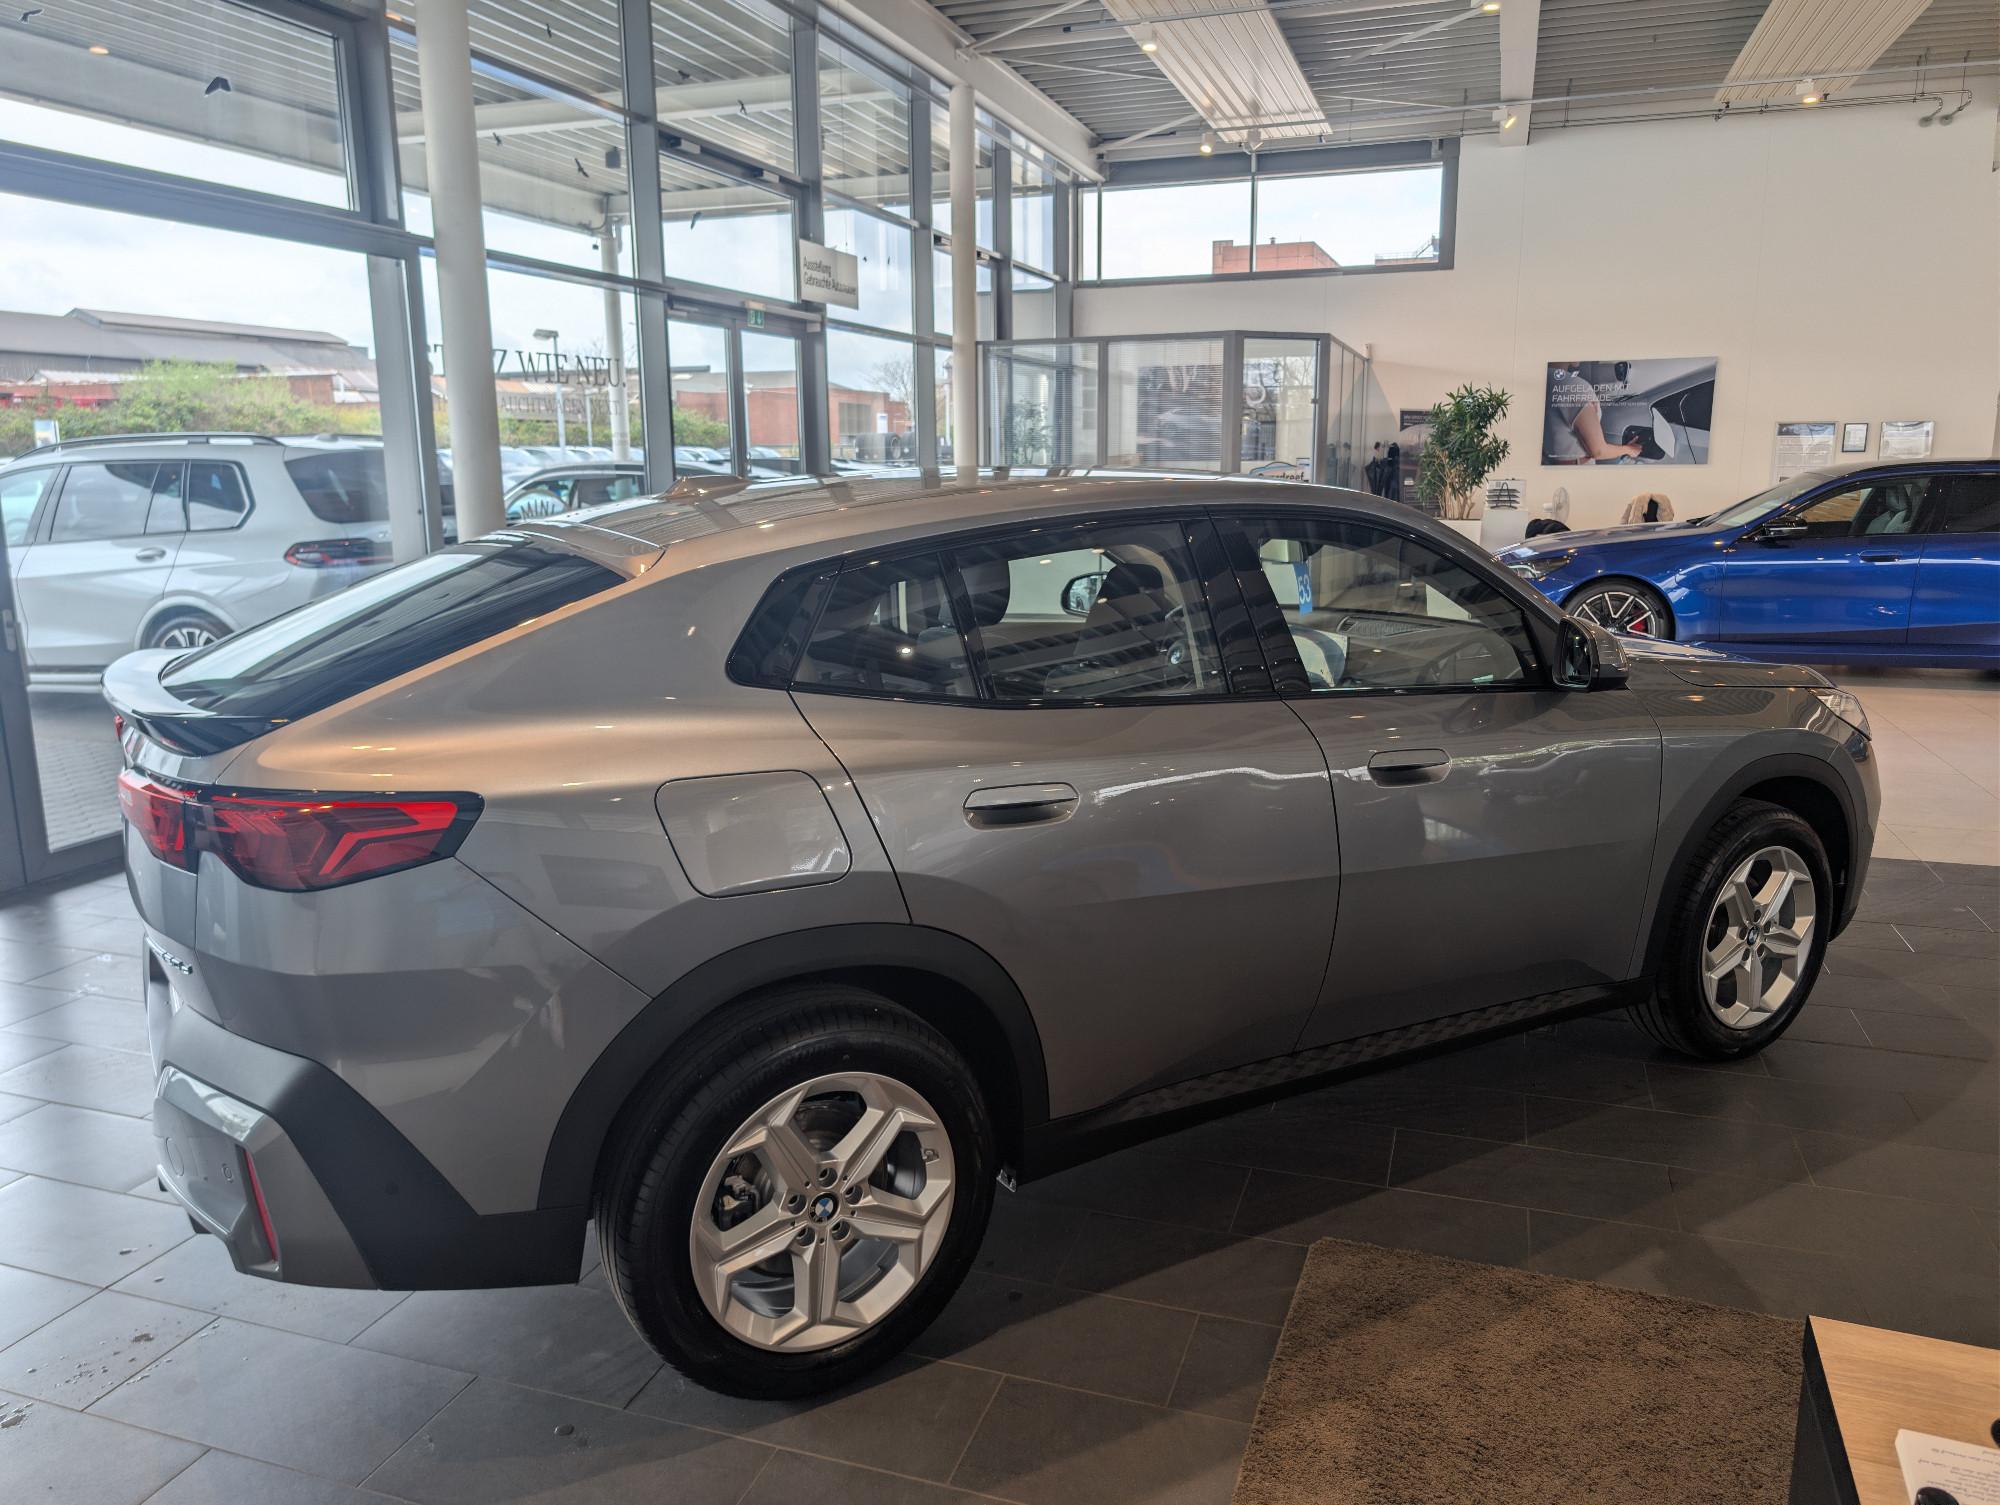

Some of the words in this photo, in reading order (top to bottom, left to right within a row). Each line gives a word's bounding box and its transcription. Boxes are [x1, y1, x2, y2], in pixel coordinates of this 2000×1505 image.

[515, 350, 569, 384] WIE
[575, 355, 626, 388] NEU.
[1552, 384, 1613, 393] AUFGELADEN
[1615, 383, 1631, 392] MIT
[520, 499, 556, 521] MINI
[1297, 573, 1311, 604] 53
